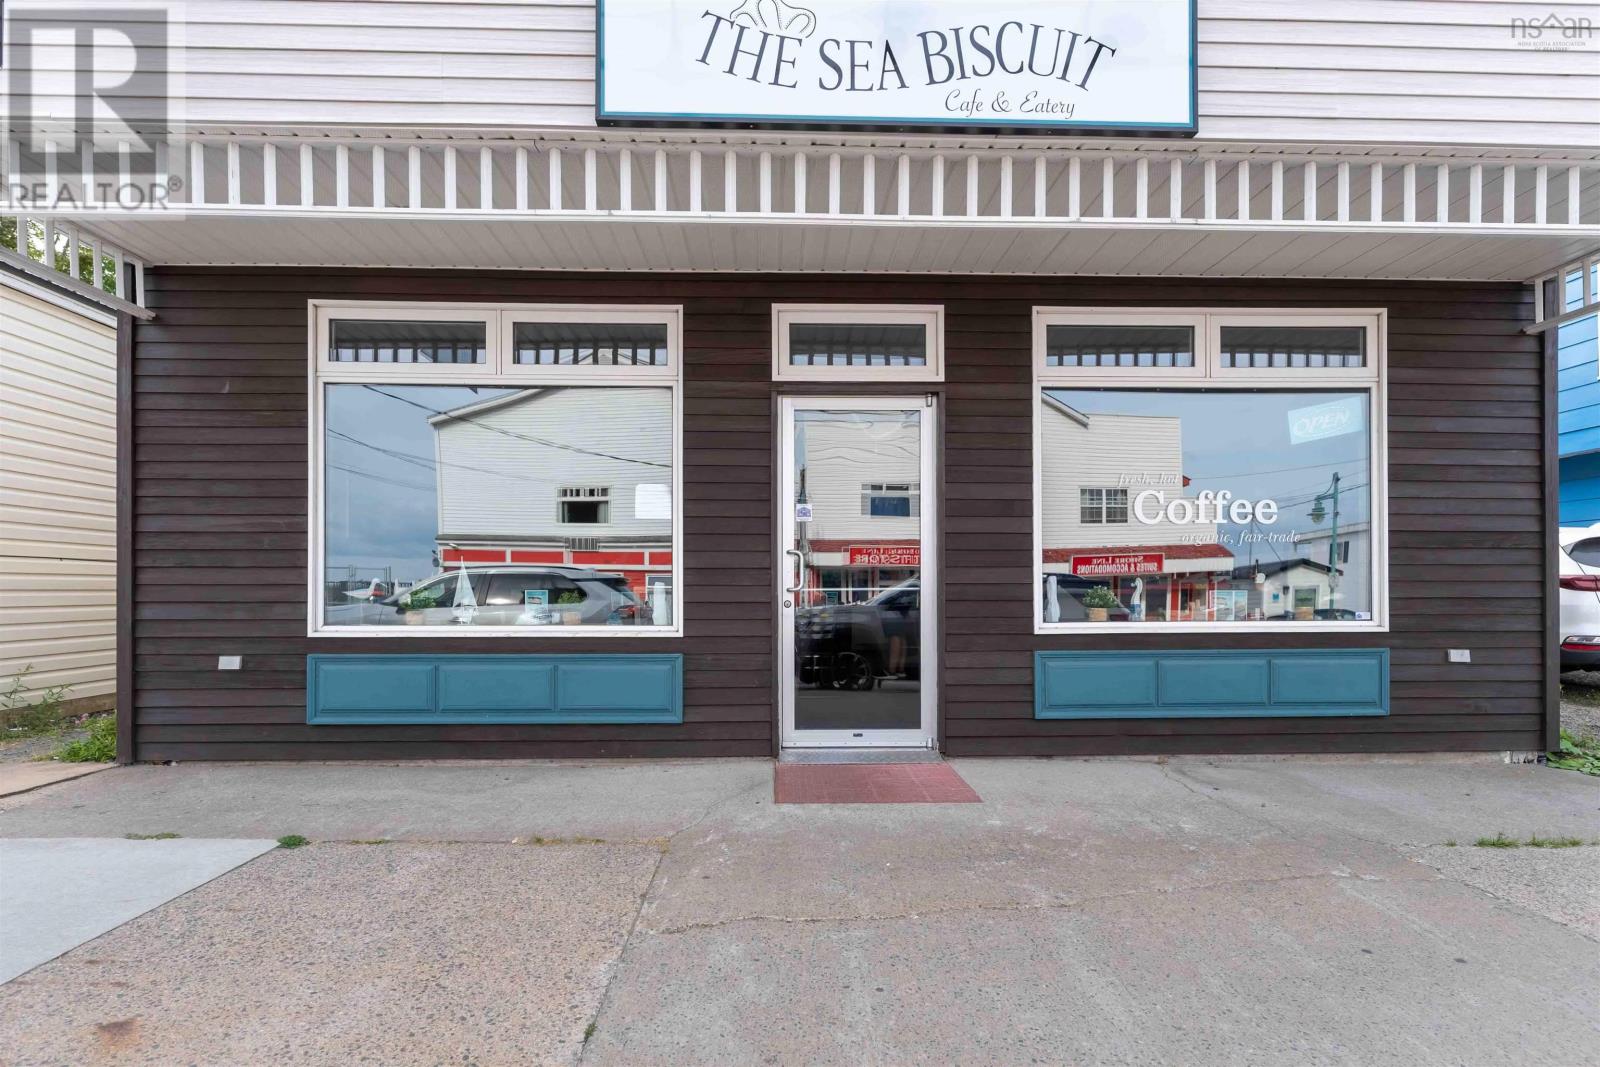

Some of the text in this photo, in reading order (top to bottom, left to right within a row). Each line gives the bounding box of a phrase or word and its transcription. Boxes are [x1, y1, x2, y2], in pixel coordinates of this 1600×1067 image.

[696, 10, 1117, 92] THE SEA BISCUIT
[945, 88, 1075, 120] Cafe & Eatery
[1293, 409, 1348, 435] OPEN
[1133, 489, 1278, 525] Coffee
[1181, 529, 1301, 547] organic, fair-trade
